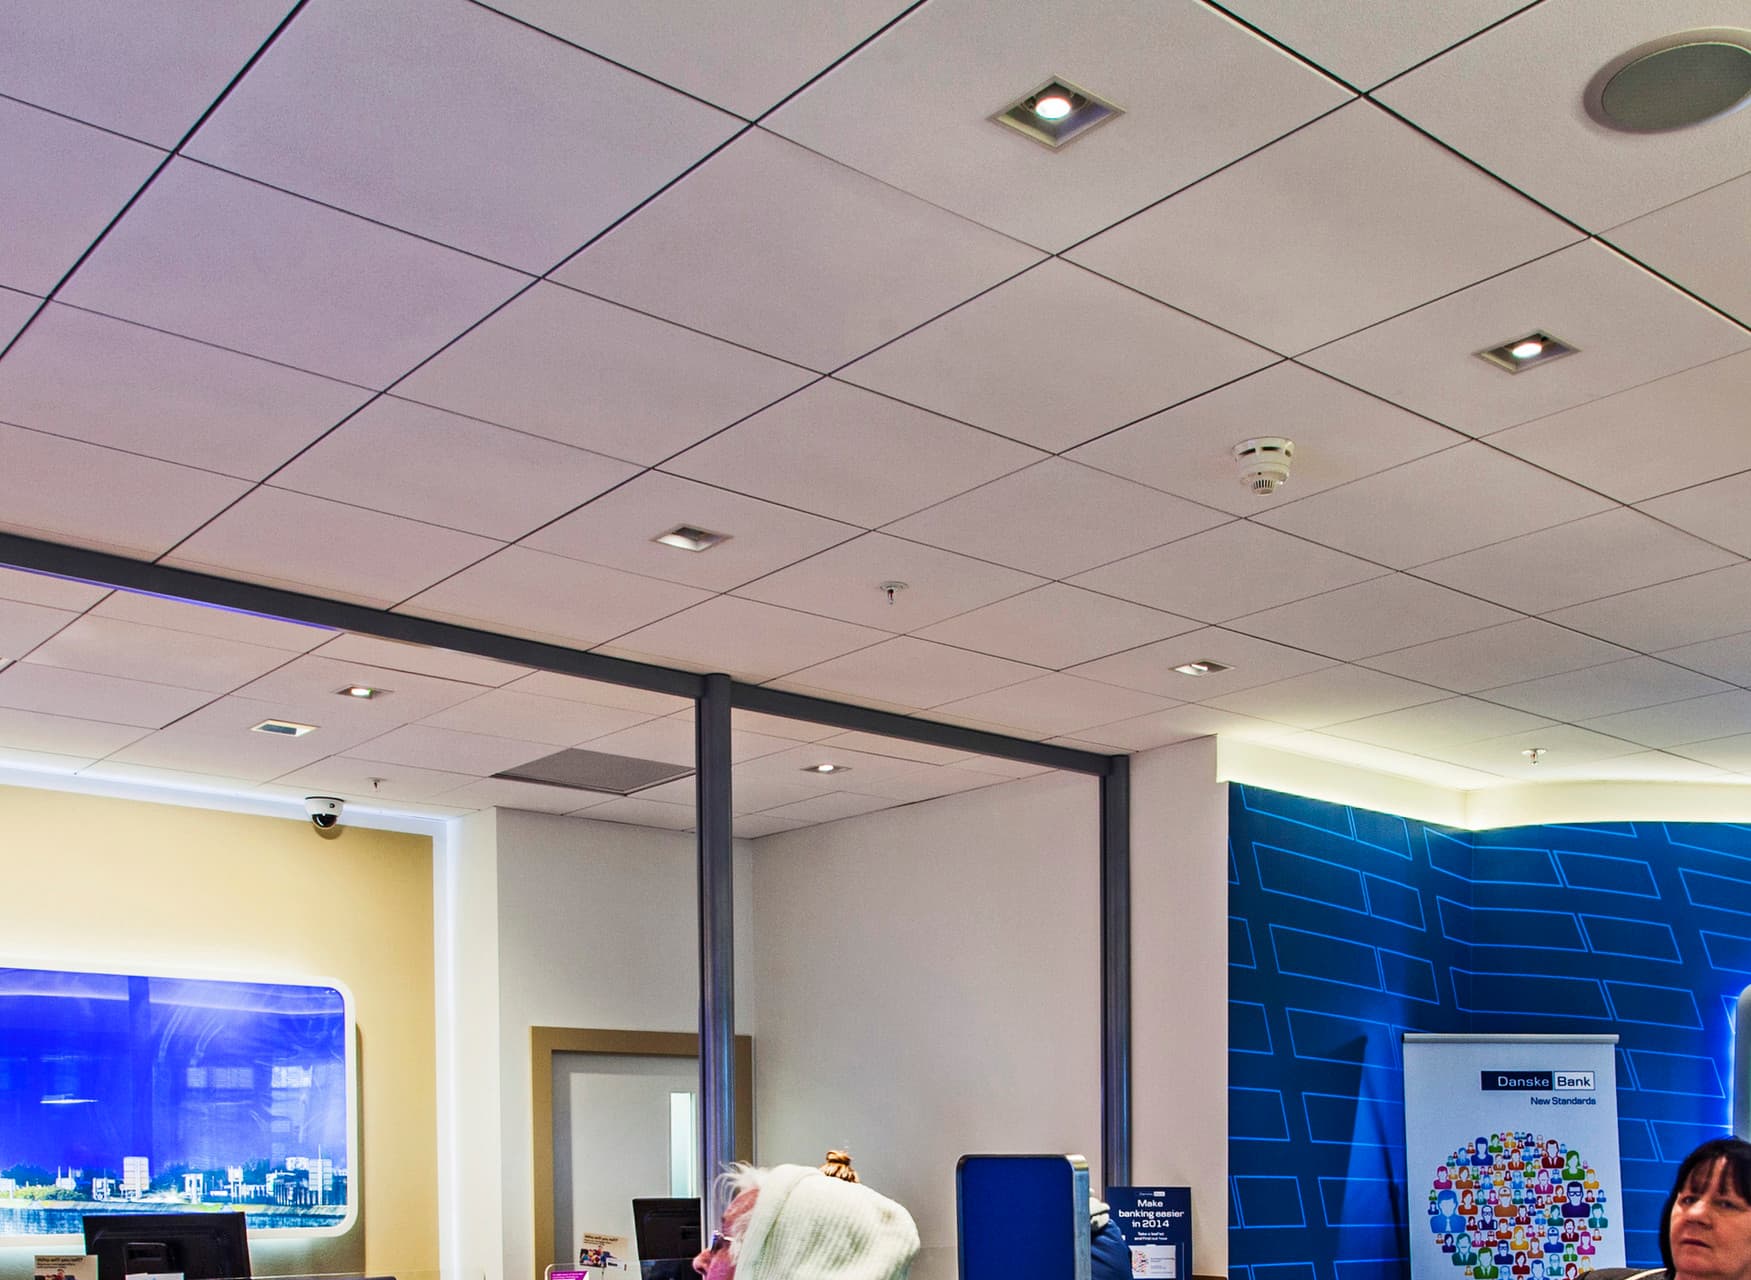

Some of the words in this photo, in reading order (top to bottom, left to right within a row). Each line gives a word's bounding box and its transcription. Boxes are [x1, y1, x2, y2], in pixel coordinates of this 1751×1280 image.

[1498, 1076, 1550, 1087] Danske
[1557, 1076, 1592, 1087] Bank
[1530, 1096, 1551, 1105] New
[1552, 1096, 1597, 1105] Standards
[1137, 1199, 1164, 1208] Make
[1118, 1208, 1155, 1220] banking
[1155, 1209, 1185, 1218] easier
[1131, 1218, 1141, 1228] in
[1142, 1219, 1170, 1228] 2014
